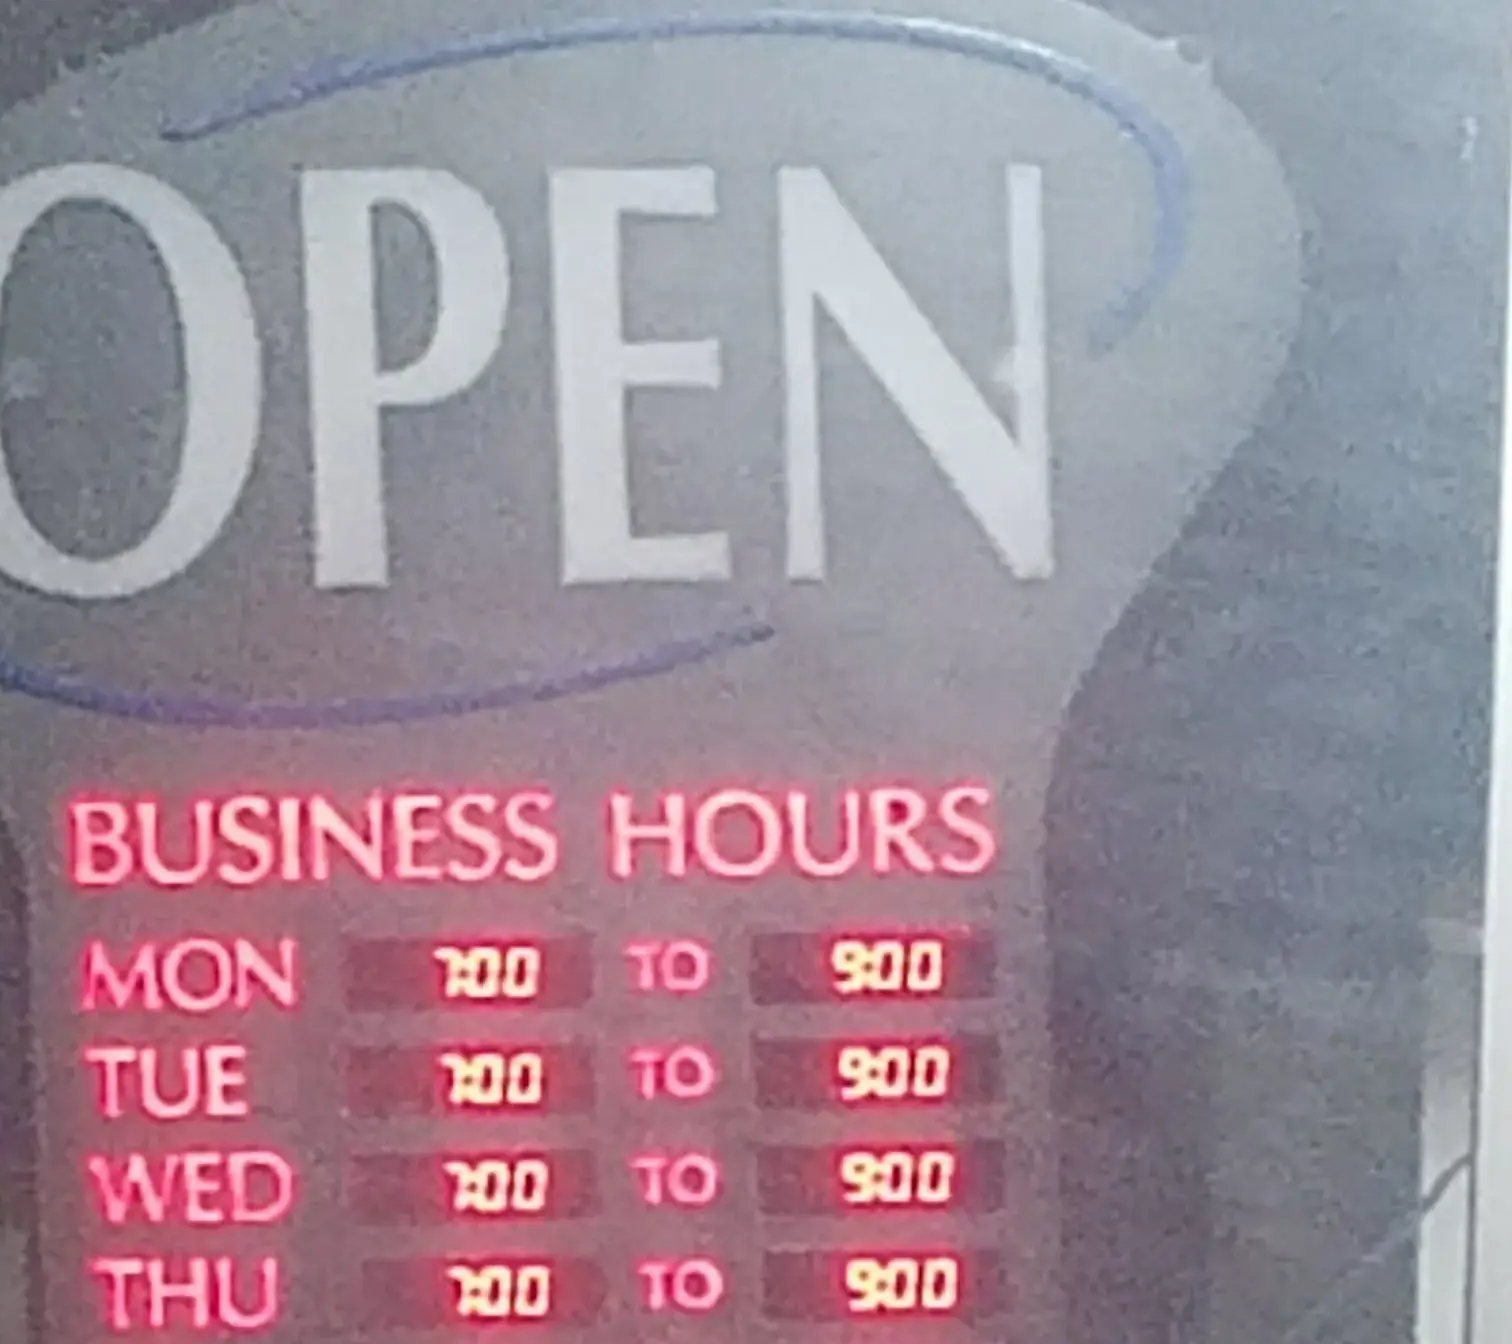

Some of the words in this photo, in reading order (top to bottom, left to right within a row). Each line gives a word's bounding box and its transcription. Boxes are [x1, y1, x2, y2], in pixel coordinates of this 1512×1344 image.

[70, 796, 560, 885] BUSINESS
[608, 788, 996, 878] HOURS
[82, 938, 299, 1012] MON
[626, 940, 710, 992] TO
[86, 1044, 249, 1118] TUE
[631, 1048, 717, 1099] TO
[90, 1150, 294, 1222] WED
[633, 1154, 719, 1204] TO
[93, 1257, 278, 1328] THU
[638, 1259, 723, 1310] TO
